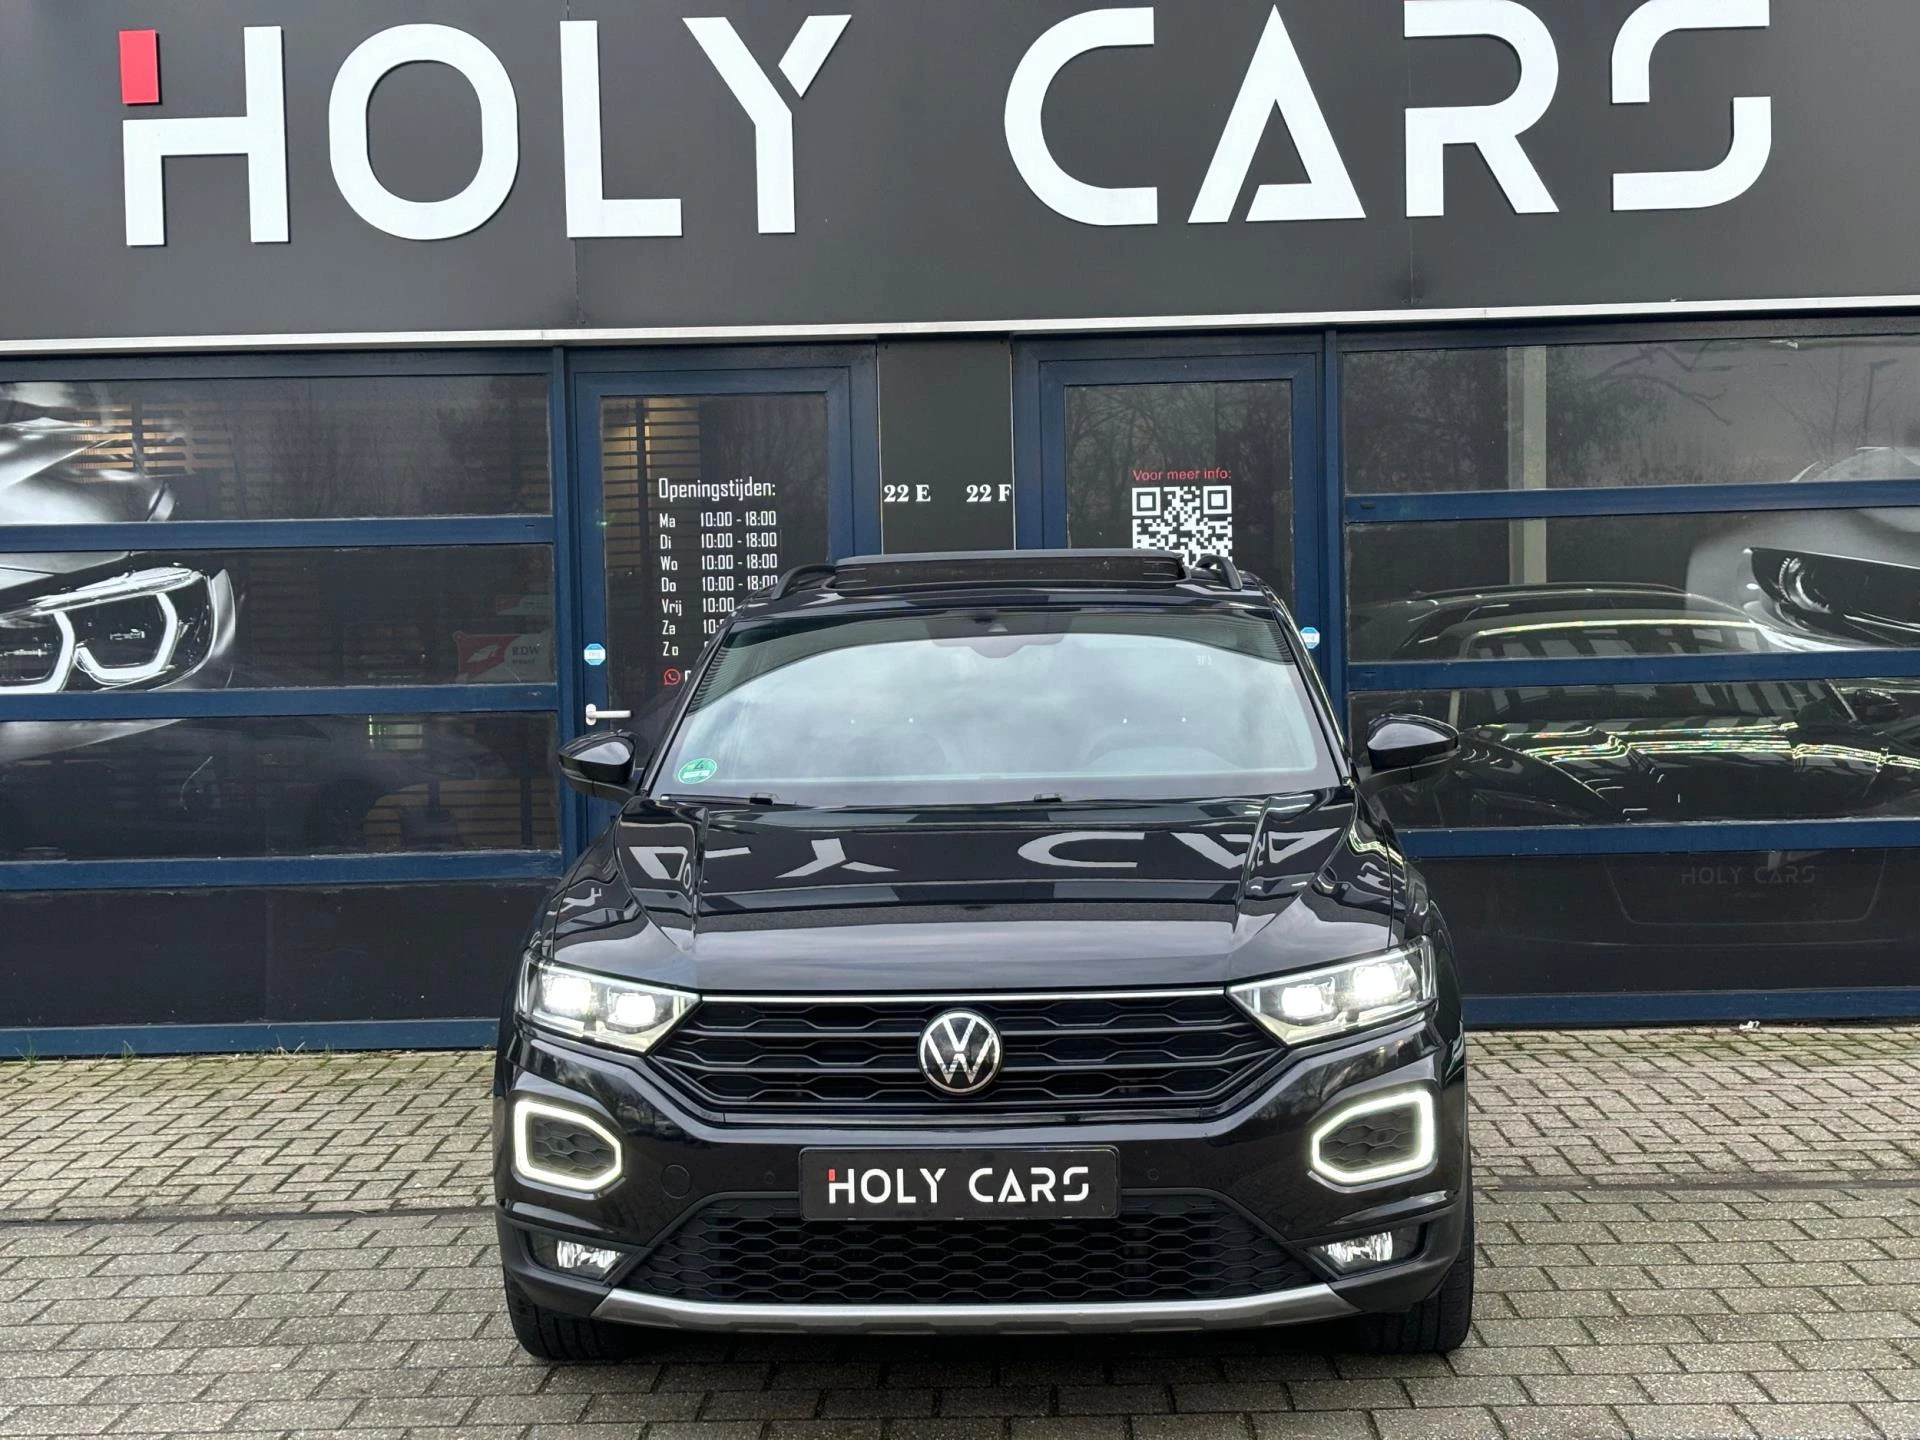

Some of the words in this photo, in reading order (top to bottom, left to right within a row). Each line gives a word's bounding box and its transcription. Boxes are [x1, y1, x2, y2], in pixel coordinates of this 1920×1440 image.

[119, 15, 852, 246] HOLY
[1004, 0, 1772, 225] CARS
[1133, 469, 1163, 481] Voor
[1167, 469, 1200, 480] meer
[1204, 467, 1232, 480] info:
[658, 476, 776, 502] Openingstijden:
[883, 485, 909, 502] 22
[916, 484, 931, 502] E
[966, 484, 992, 502] 22
[998, 484, 1012, 502] F
[659, 513, 676, 528] Ma
[700, 511, 733, 527] 10:00
[745, 511, 777, 526] 18:00
[660, 534, 672, 549] Di
[701, 533, 733, 548] 10:00
[745, 533, 777, 547] 18:00
[660, 556, 678, 571] Wo
[701, 555, 734, 570] 10:00
[746, 554, 778, 569] 18:00
[661, 577, 677, 592] Do
[702, 576, 734, 591] 10:00
[661, 598, 682, 616] Vrij
[703, 597, 735, 613] 10:00
[662, 620, 676, 635] Za
[512, 646, 541, 656] RDW
[1680, 866, 1743, 885] HOLY
[827, 1168, 947, 1204] HOLY
[968, 1166, 1089, 1203] CARS
